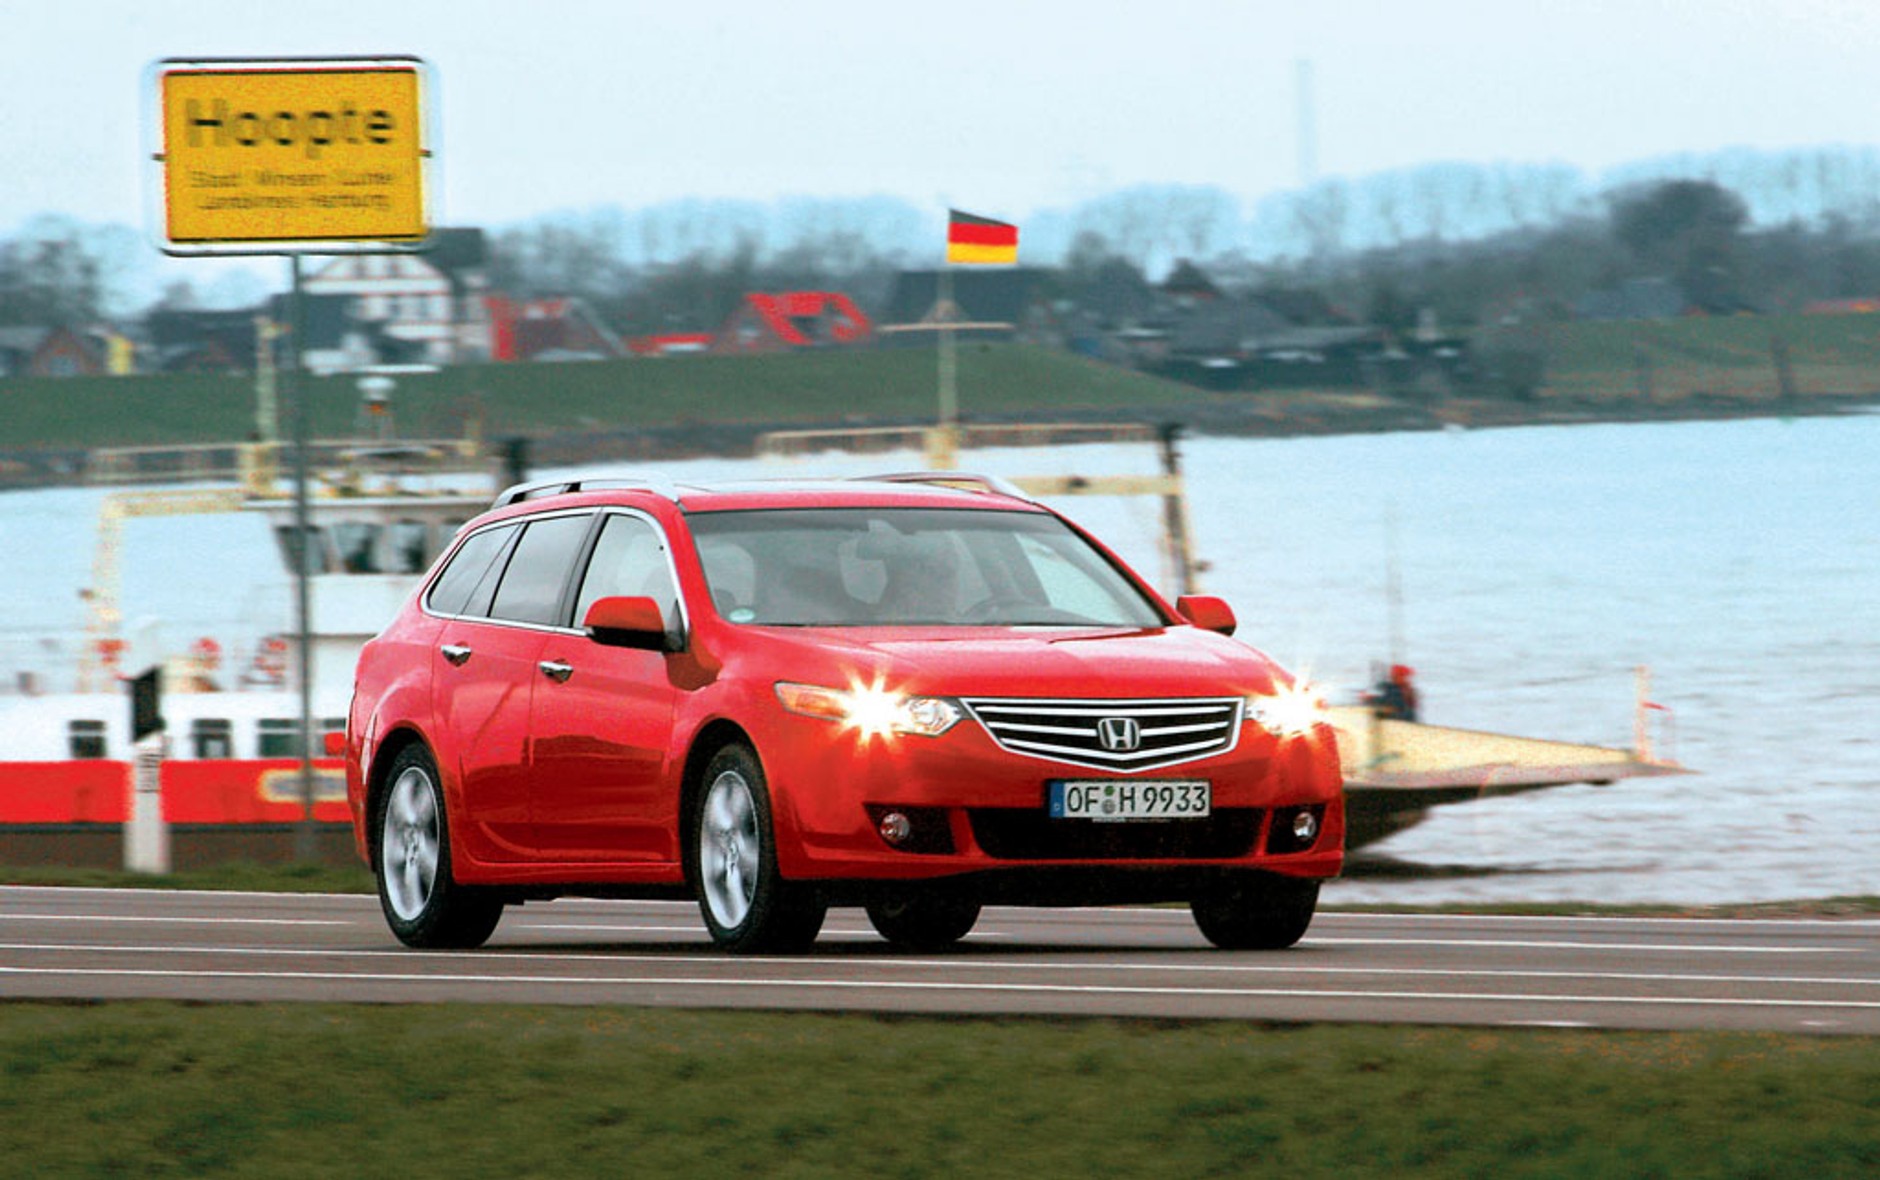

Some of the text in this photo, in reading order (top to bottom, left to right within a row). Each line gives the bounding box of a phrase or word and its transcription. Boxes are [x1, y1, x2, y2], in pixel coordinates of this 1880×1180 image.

[186, 98, 396, 160] Hoopte
[1067, 786, 1206, 813] OF H 9933
